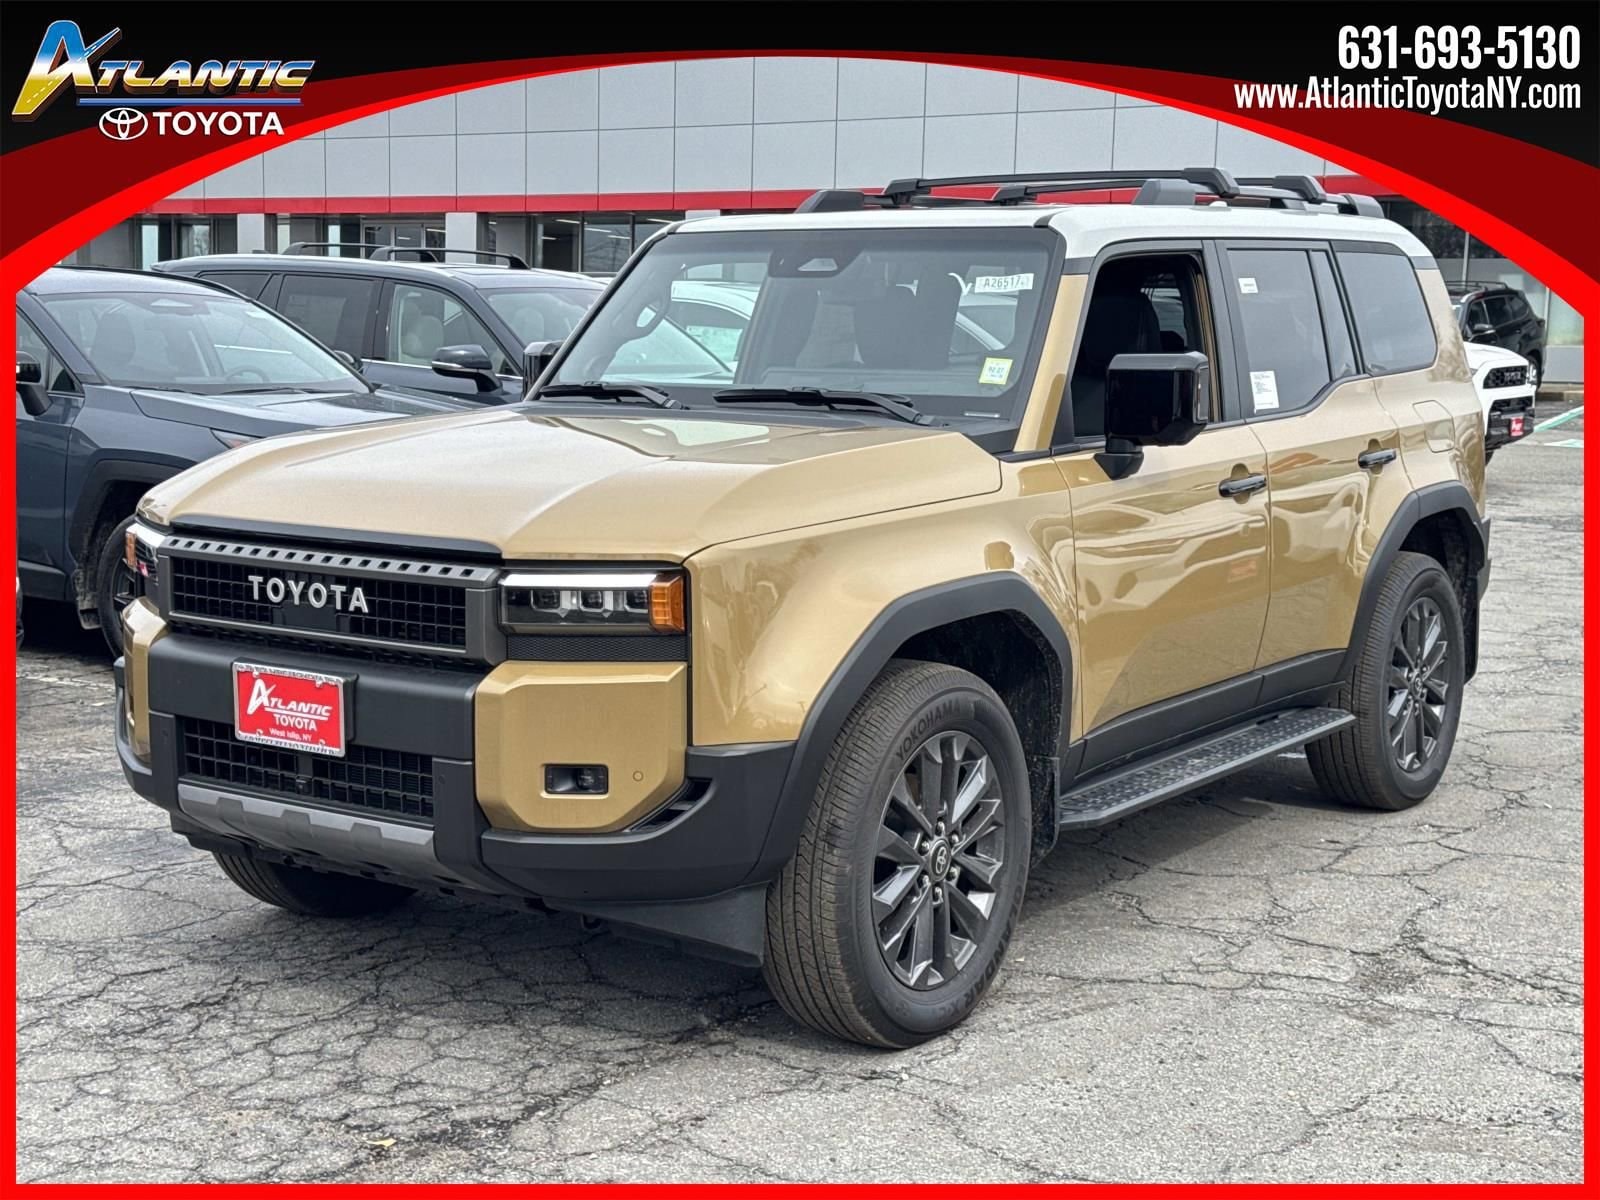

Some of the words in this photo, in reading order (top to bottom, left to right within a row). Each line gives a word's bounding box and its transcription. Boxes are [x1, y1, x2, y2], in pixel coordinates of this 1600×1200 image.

[247, 575, 369, 613] TOYOTA
[246, 678, 333, 716] ATLANTIC
[268, 727, 286, 737] West
[302, 733, 313, 742] NY
[273, 713, 317, 732] TOYOTA
[895, 698, 962, 761] YOKOHAMA
